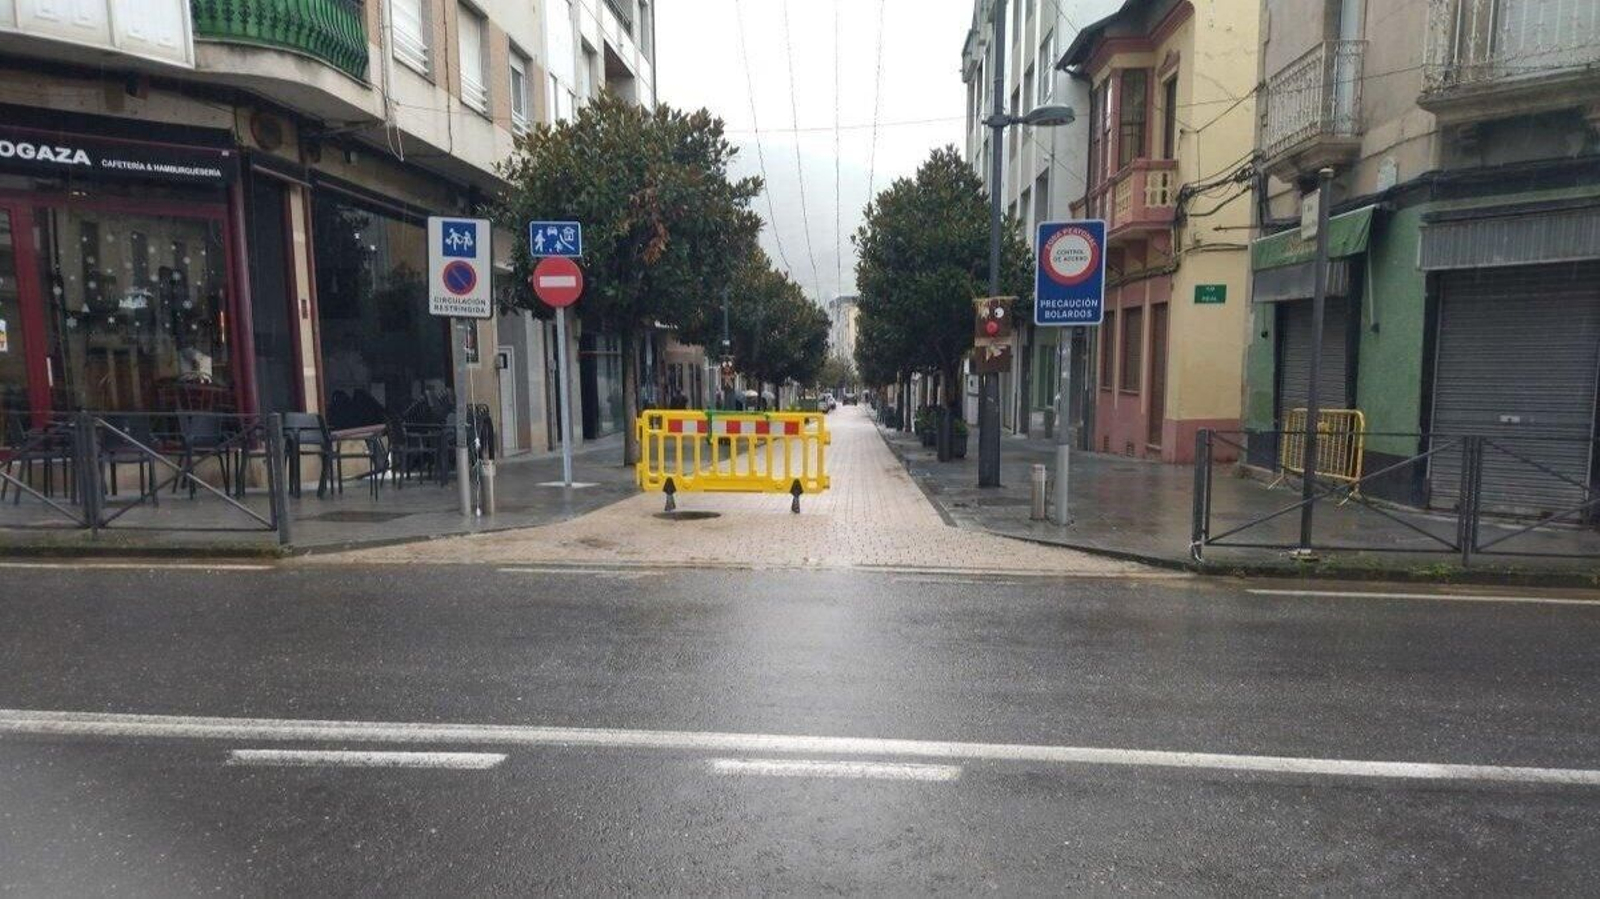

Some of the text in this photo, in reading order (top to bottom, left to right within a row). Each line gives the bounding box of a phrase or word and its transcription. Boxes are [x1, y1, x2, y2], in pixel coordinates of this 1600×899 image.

[101, 159, 146, 172] CAFETERÍA
[146, 163, 153, 172] &
[434, 296, 486, 306] CIRCULACIÓN
[1040, 297, 1098, 309] PRECAUCIÓN
[434, 305, 486, 314] RESTRINGIDA
[1045, 310, 1092, 318] BOLARDOS
